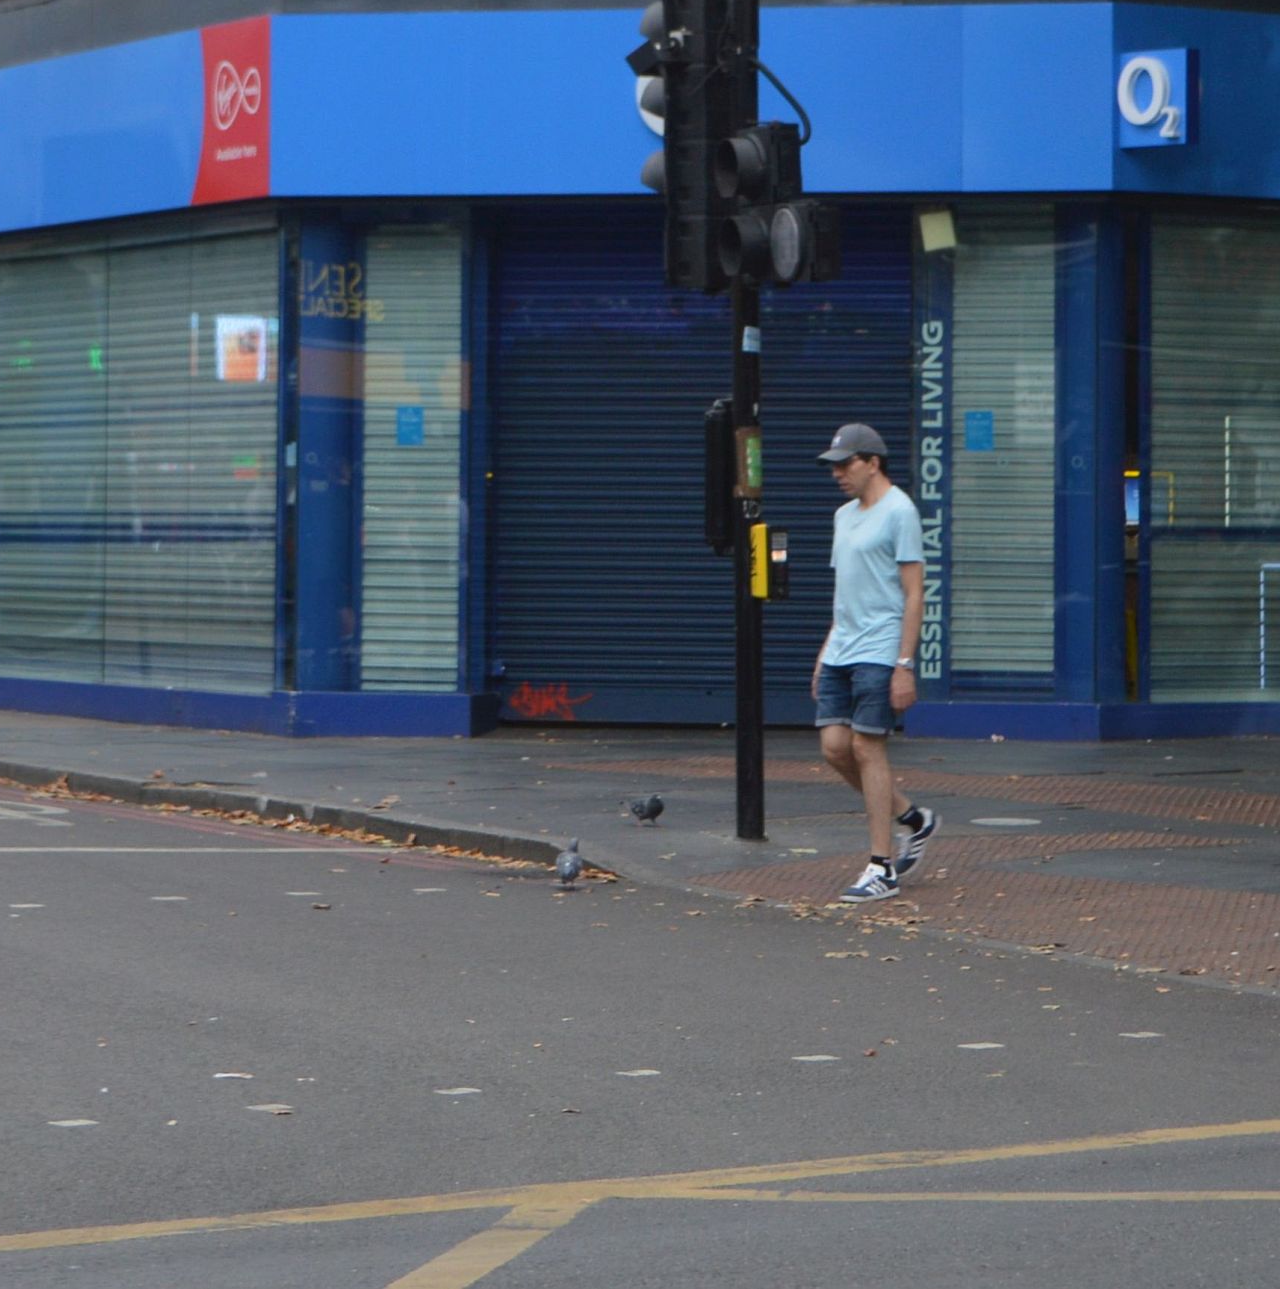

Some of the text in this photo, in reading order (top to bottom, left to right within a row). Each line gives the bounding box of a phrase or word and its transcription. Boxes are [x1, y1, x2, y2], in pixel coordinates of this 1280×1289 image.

[920, 319, 944, 679] ESSENTIAL FOR LIVING
